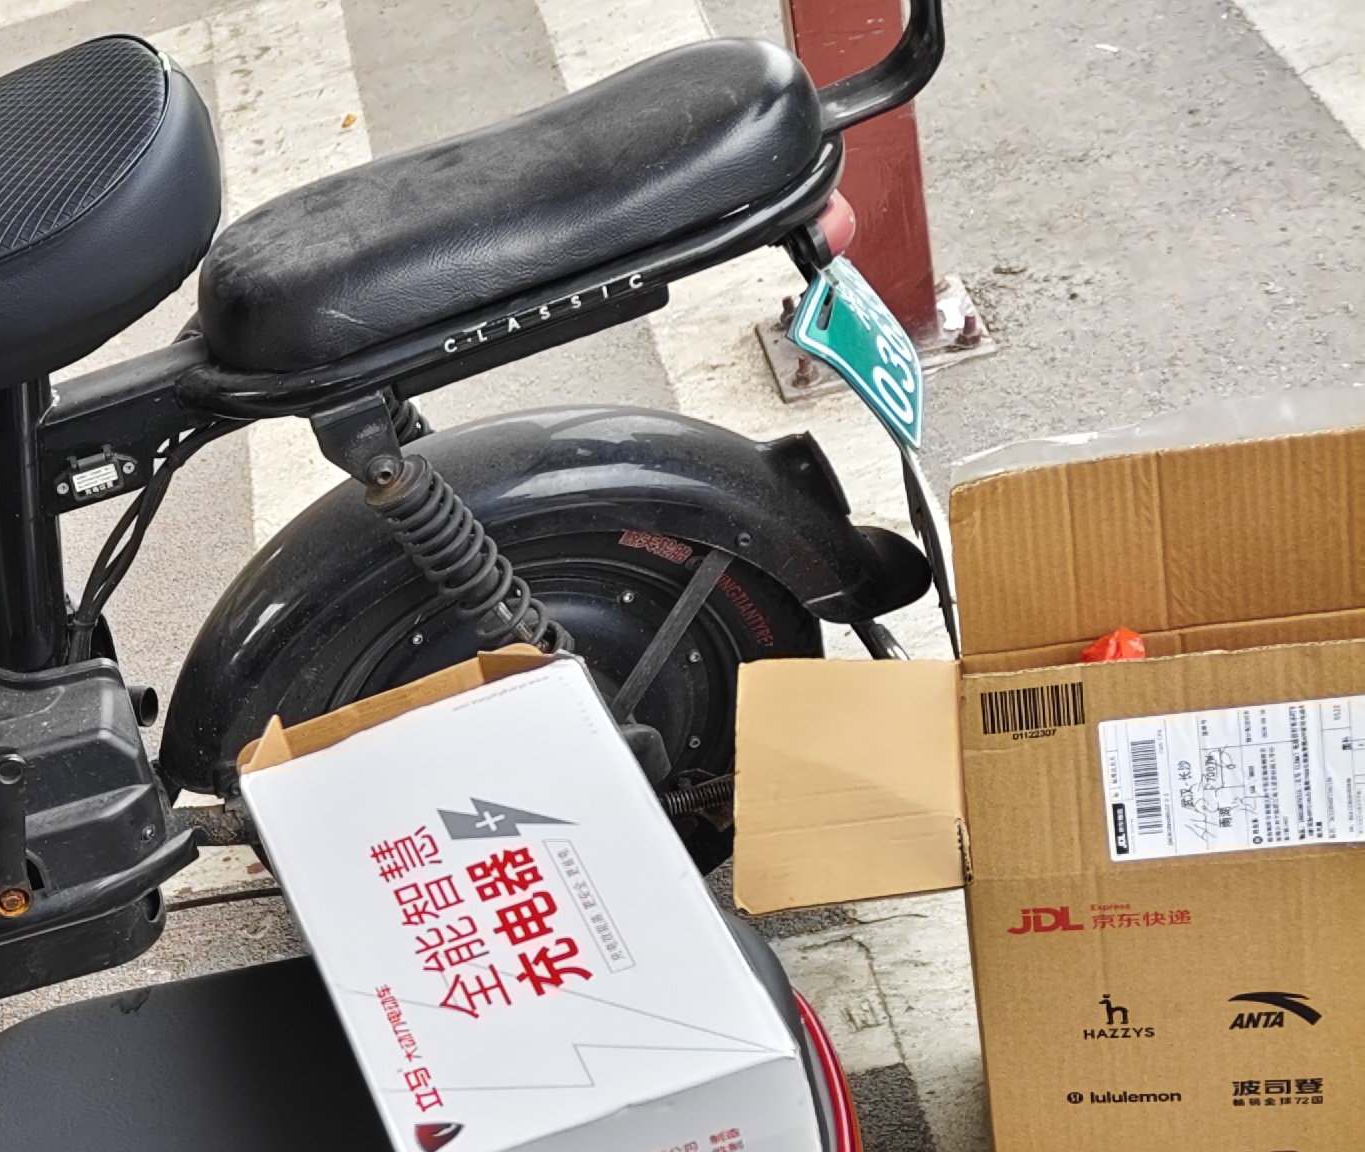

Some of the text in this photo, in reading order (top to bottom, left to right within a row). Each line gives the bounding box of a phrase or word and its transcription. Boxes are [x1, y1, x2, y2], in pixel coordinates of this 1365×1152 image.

[444, 274, 643, 353] CLASSIC
[1090, 903, 1131, 911] Express
[370, 825, 512, 1018] 全能智慧
[466, 847, 593, 996] 充电器
[1007, 906, 1085, 935] JDL
[1092, 909, 1192, 930] 京东快递
[1228, 1011, 1284, 1030] ANTA
[1082, 1027, 1155, 1040] HAZZYS
[404, 1066, 444, 1112] 立马
[1090, 1090, 1182, 1104] lululemon
[1232, 1077, 1323, 1096] 波司登
